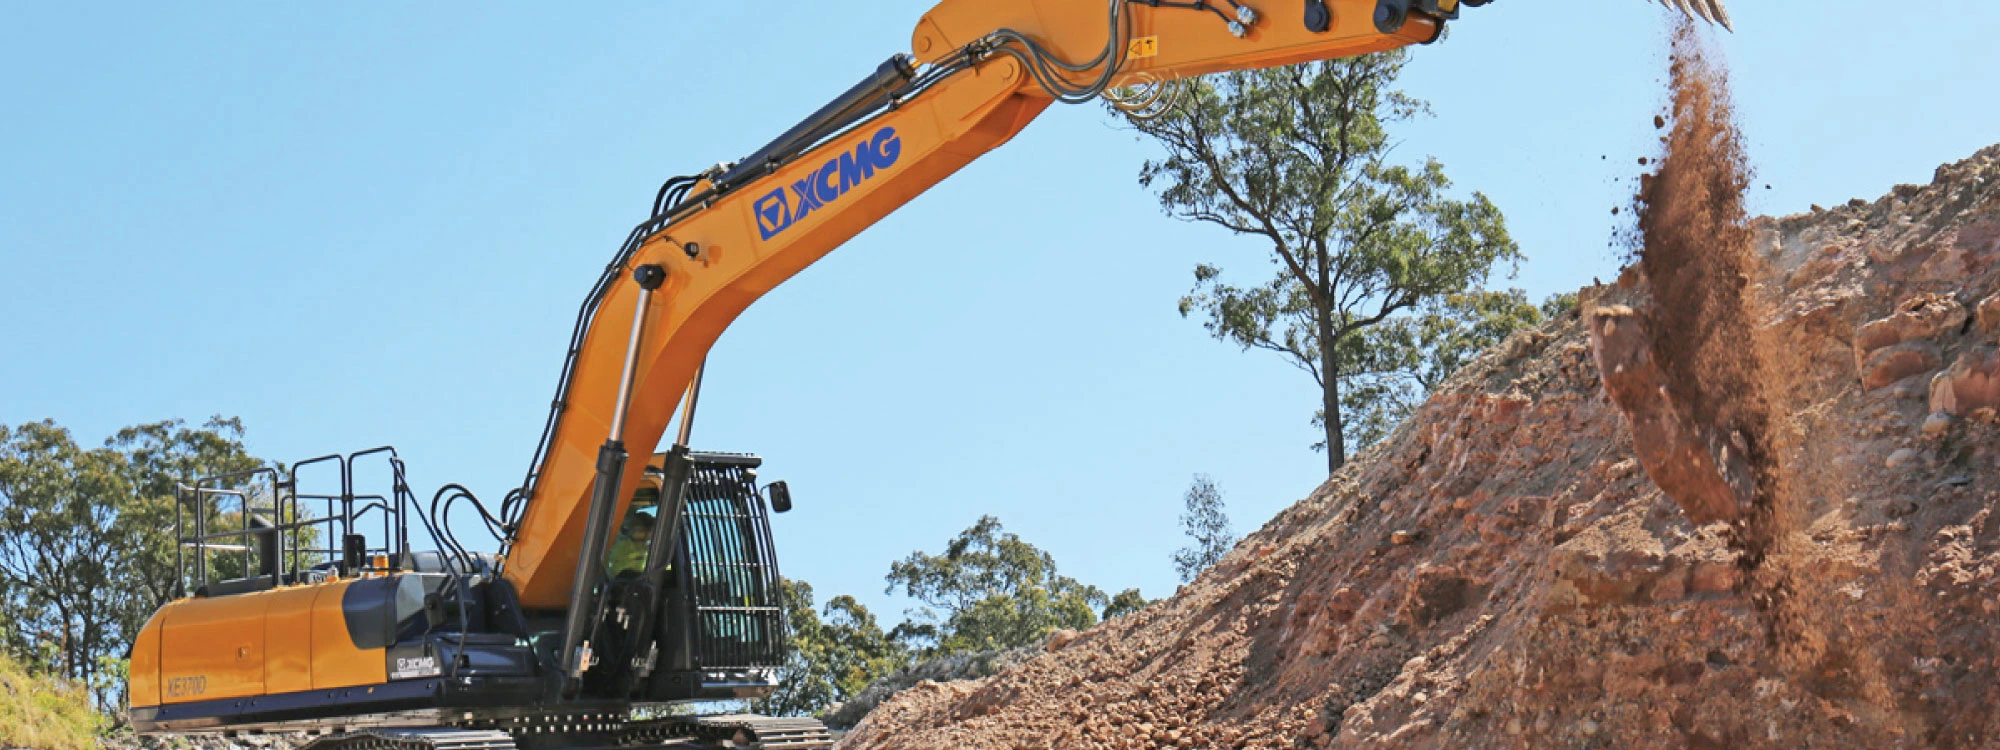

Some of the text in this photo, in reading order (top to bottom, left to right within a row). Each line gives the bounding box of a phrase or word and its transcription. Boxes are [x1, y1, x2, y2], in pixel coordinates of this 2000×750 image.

[791, 126, 902, 224] XCMG
[406, 657, 434, 670] XCMG
[167, 675, 207, 698] XE370D
